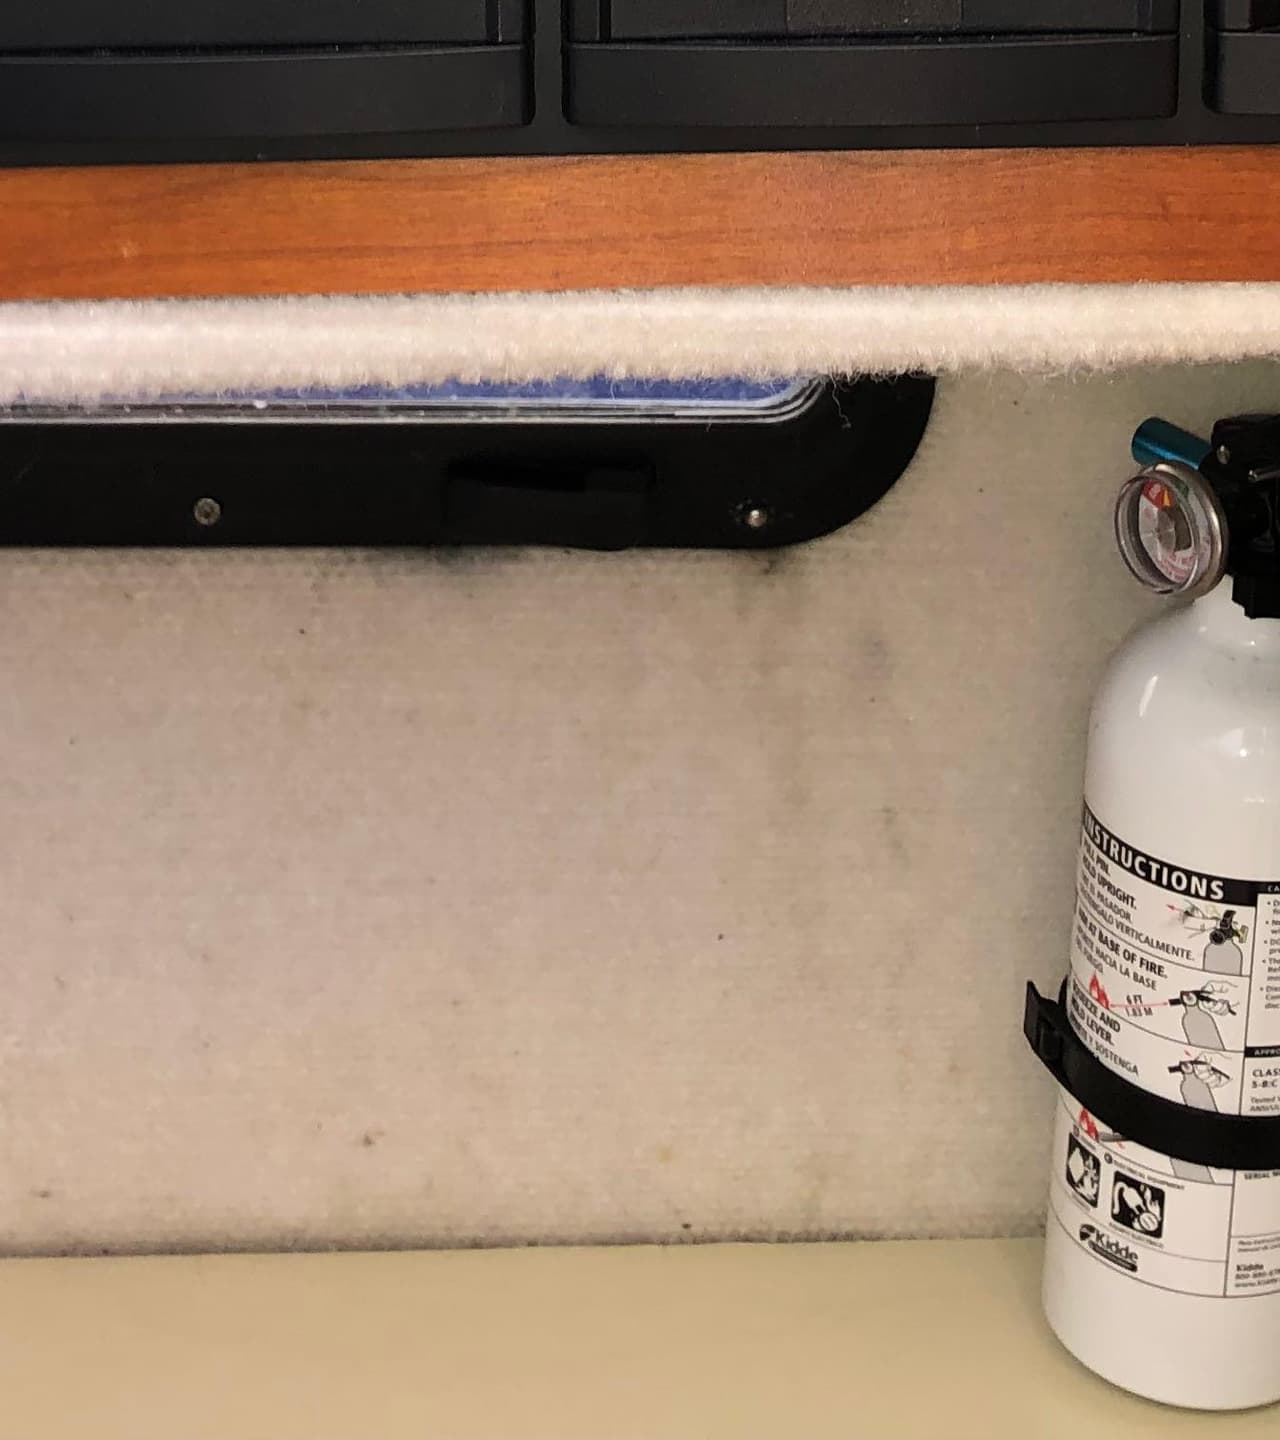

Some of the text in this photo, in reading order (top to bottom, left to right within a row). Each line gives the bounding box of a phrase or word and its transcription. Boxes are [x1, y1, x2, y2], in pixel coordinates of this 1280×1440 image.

[1084, 810, 1224, 901] INSTRUCTIONS
[1098, 931, 1121, 957] BASE
[1122, 948, 1138, 965] OF
[1139, 957, 1168, 979] FIRE.
[1119, 963, 1130, 978] LA
[1133, 968, 1157, 991] BASE
[1099, 1011, 1121, 1033] AND
[1094, 1228, 1139, 1261] Kidde
